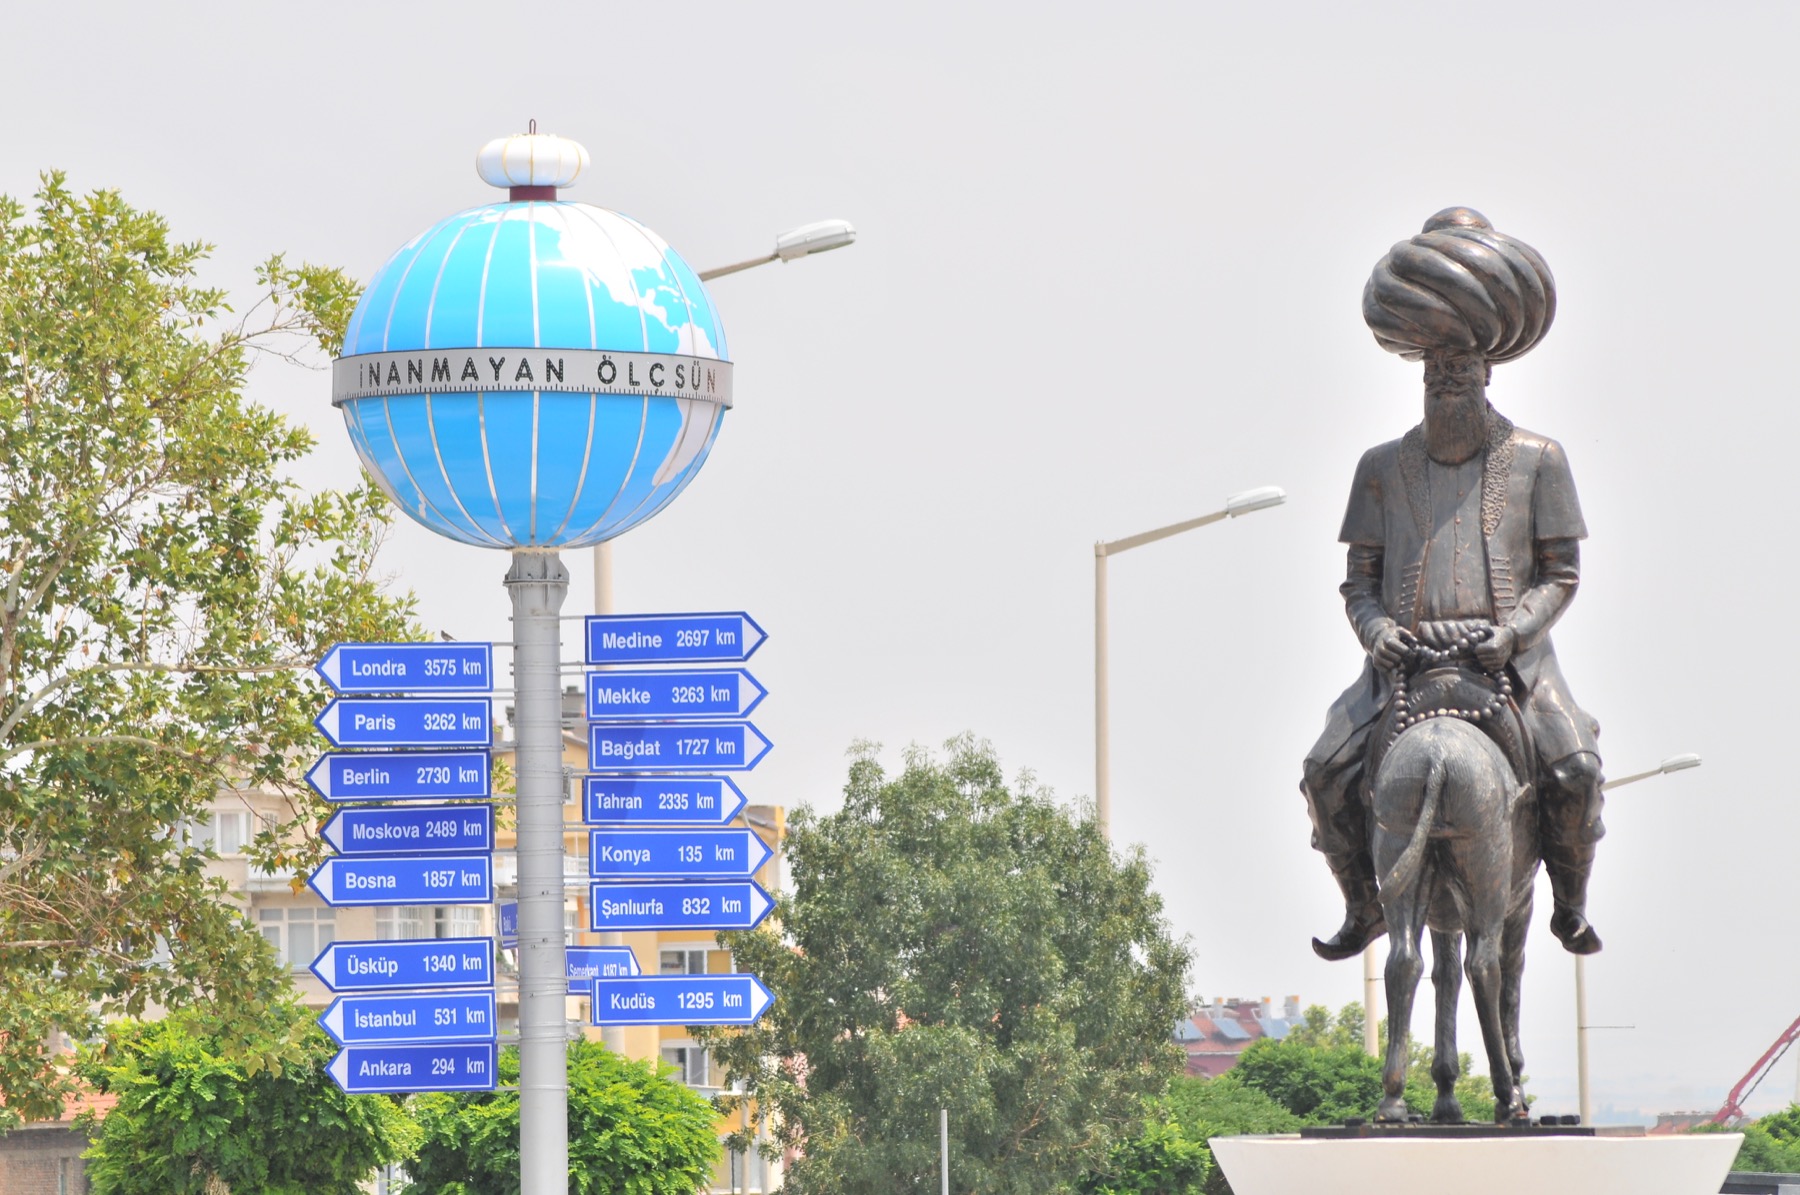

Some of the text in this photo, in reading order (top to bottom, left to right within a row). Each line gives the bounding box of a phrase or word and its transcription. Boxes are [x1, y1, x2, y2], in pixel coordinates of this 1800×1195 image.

[359, 354, 716, 393] İNANMAYAN ÖLÇSÜN
[603, 629, 735, 649] Medine 2697 km
[353, 659, 481, 676] Londra 3575 km
[598, 685, 730, 704] Mekke 3263 km
[355, 713, 481, 730] Paris 3262 km
[602, 738, 735, 759] Bağdat 1727 km
[343, 767, 478, 785] Berlin 2730 km
[596, 793, 713, 809] Tahran 2335 km
[353, 820, 481, 839] Moskova 2489 km
[602, 845, 734, 865] Konya 135 km
[346, 870, 480, 888] Bosna 1857 km
[602, 897, 741, 919] Şanlıurfa 832 km
[348, 954, 481, 977] Üsküp 1340 km
[618, 962, 628, 976] km
[611, 991, 742, 1009] Kudüs 1295 km
[355, 1007, 485, 1028] İstanbul 531 km
[359, 1057, 484, 1076] Ankara 294 km
